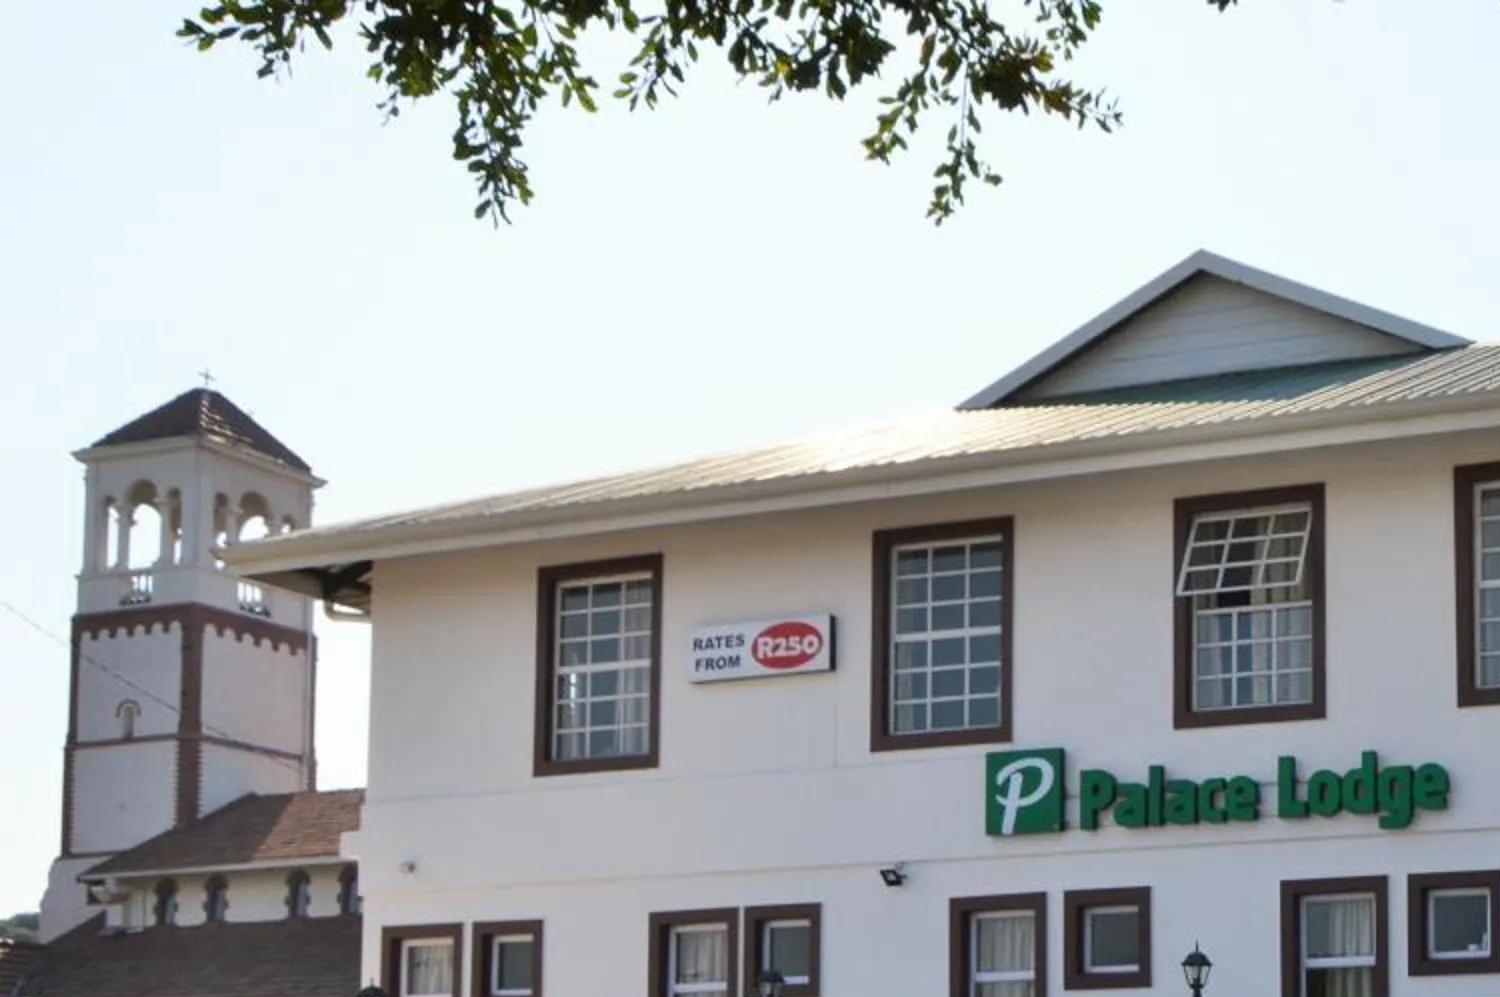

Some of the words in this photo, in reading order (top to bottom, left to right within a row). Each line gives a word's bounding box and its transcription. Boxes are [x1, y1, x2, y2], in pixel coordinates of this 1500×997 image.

[693, 633, 745, 651] RATES
[756, 634, 820, 659] R250
[695, 655, 741, 672] FROM
[996, 757, 1054, 834] P
[1080, 765, 1259, 830] Palace
[1278, 750, 1450, 829] Lodge
